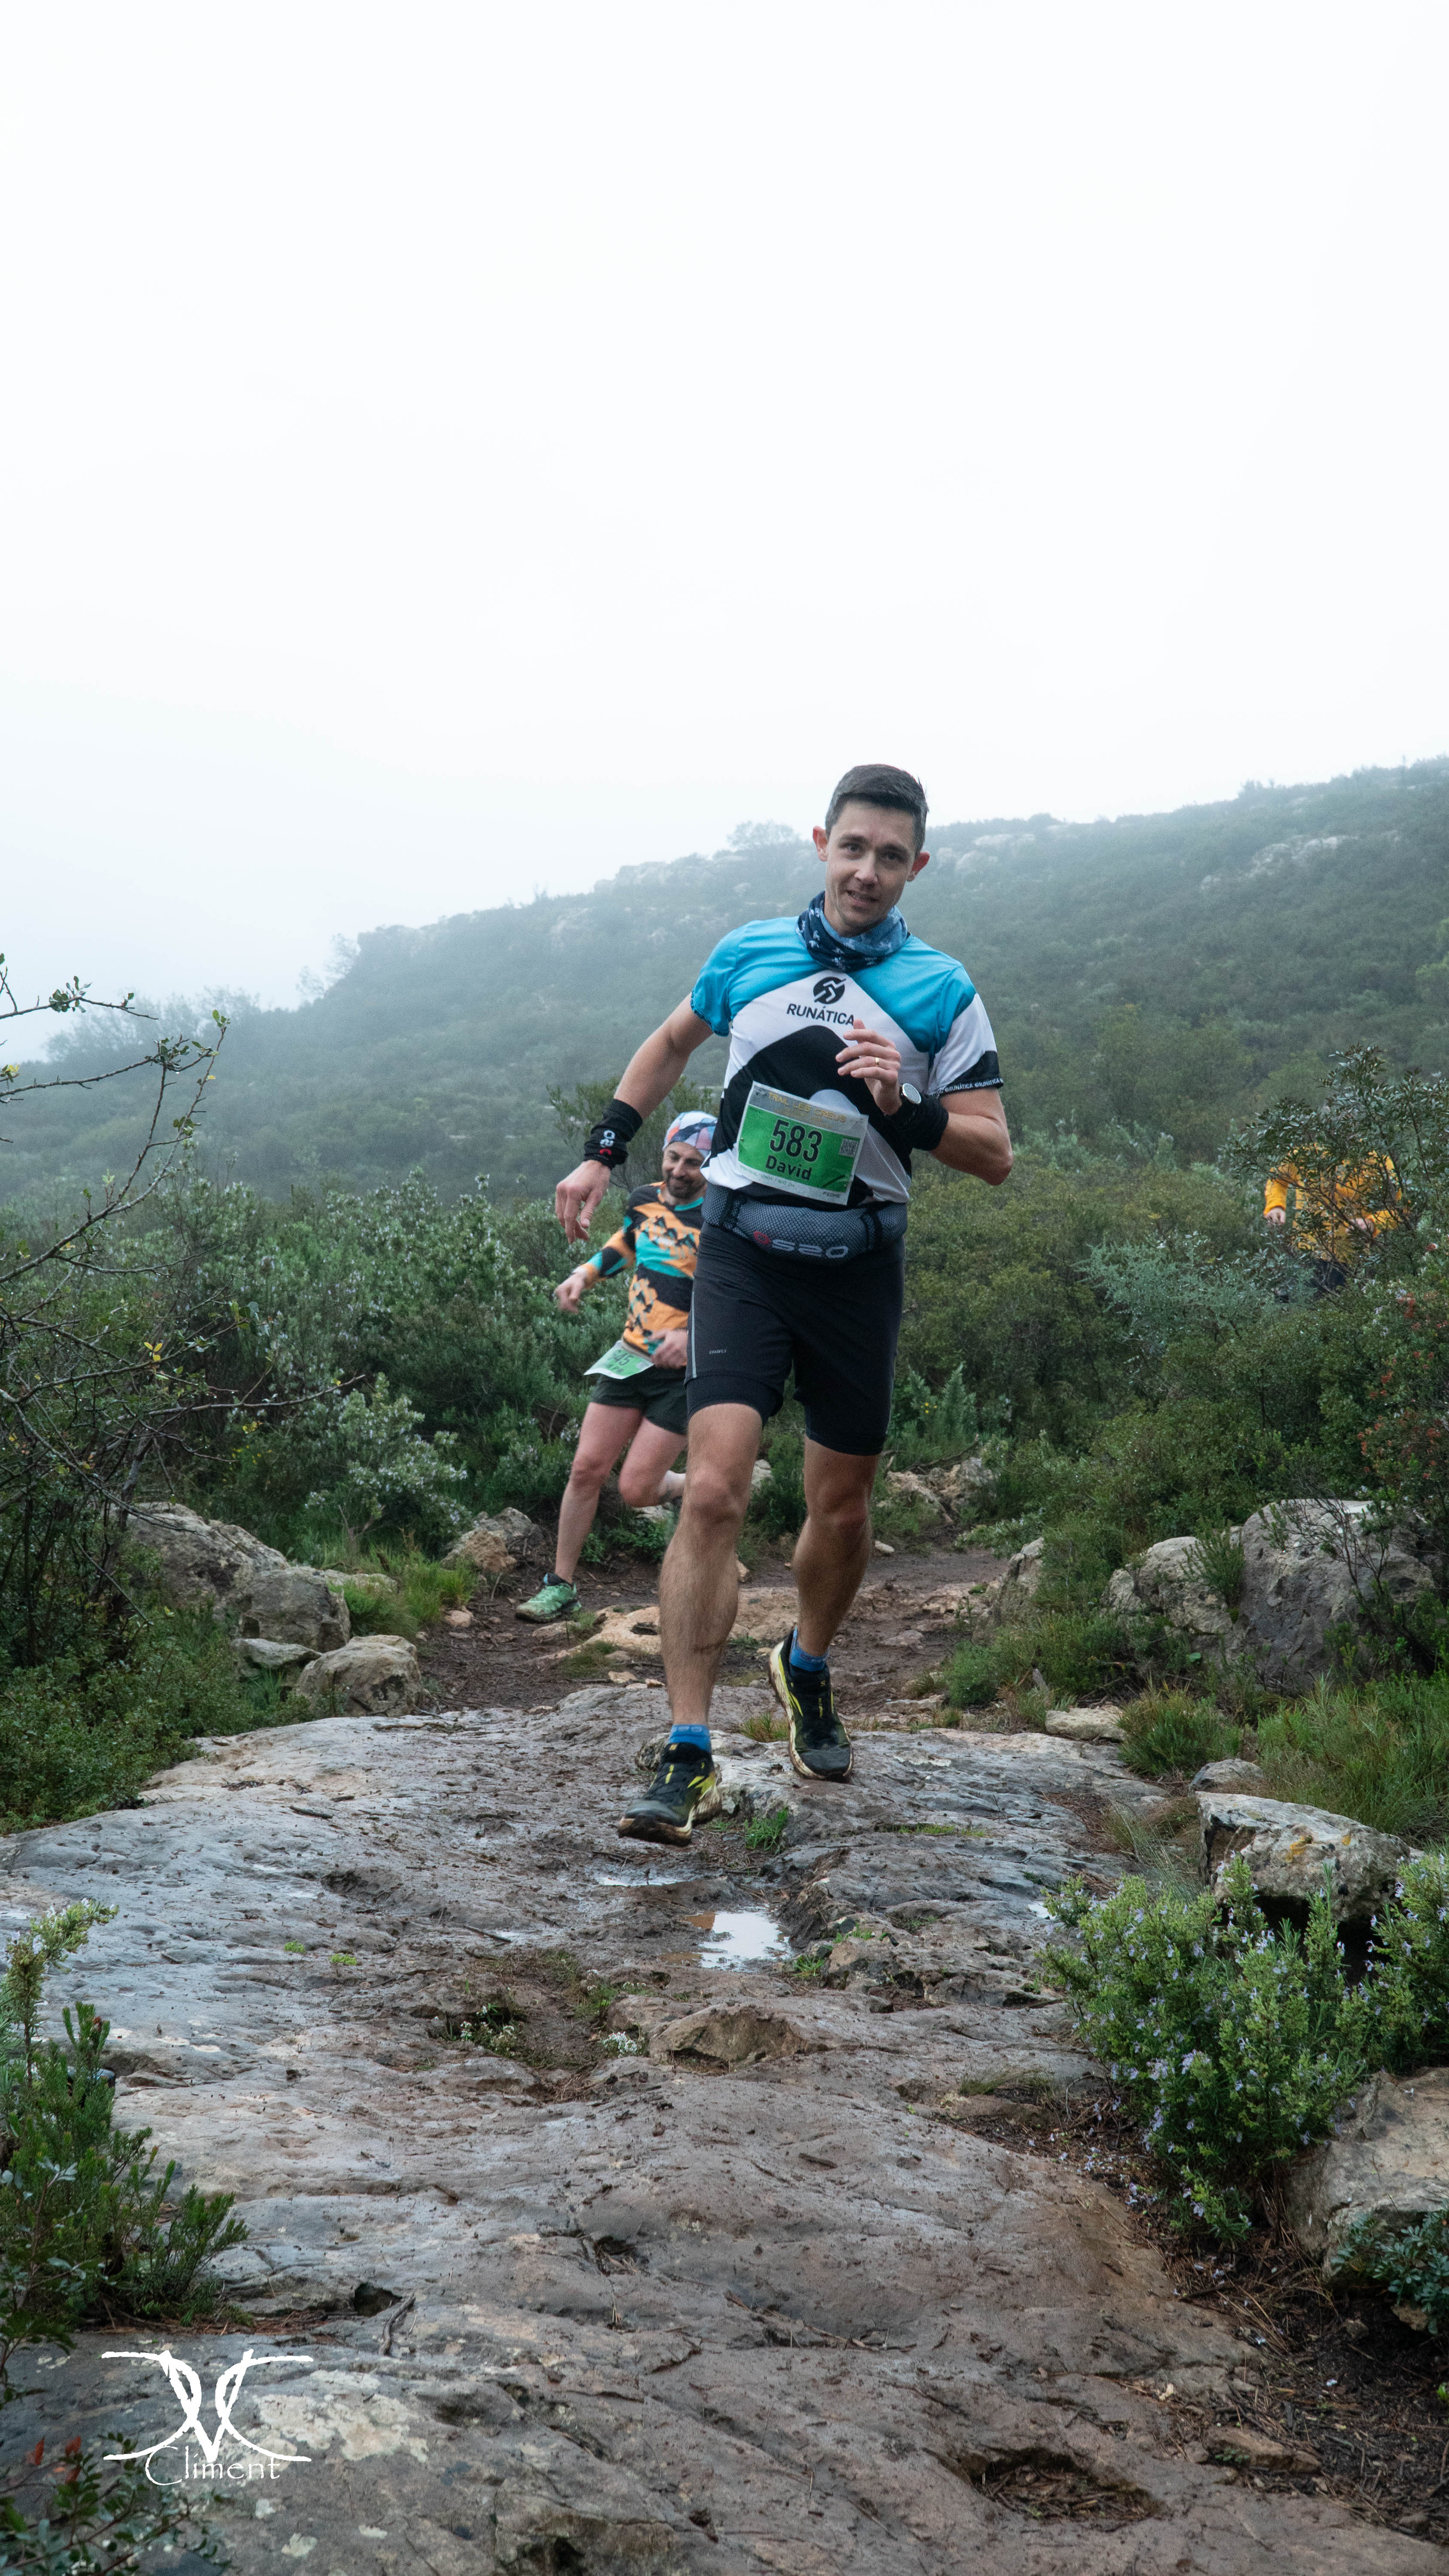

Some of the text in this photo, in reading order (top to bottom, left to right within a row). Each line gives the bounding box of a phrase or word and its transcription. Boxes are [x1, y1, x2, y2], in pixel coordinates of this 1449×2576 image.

[787, 1003, 854, 1026] RUNÁTICA
[768, 1092, 788, 1106] TRAIL
[793, 1103, 811, 1112] LES
[815, 1109, 847, 1122] CREUS
[770, 1119, 822, 1162] 583
[766, 1155, 812, 1180] David
